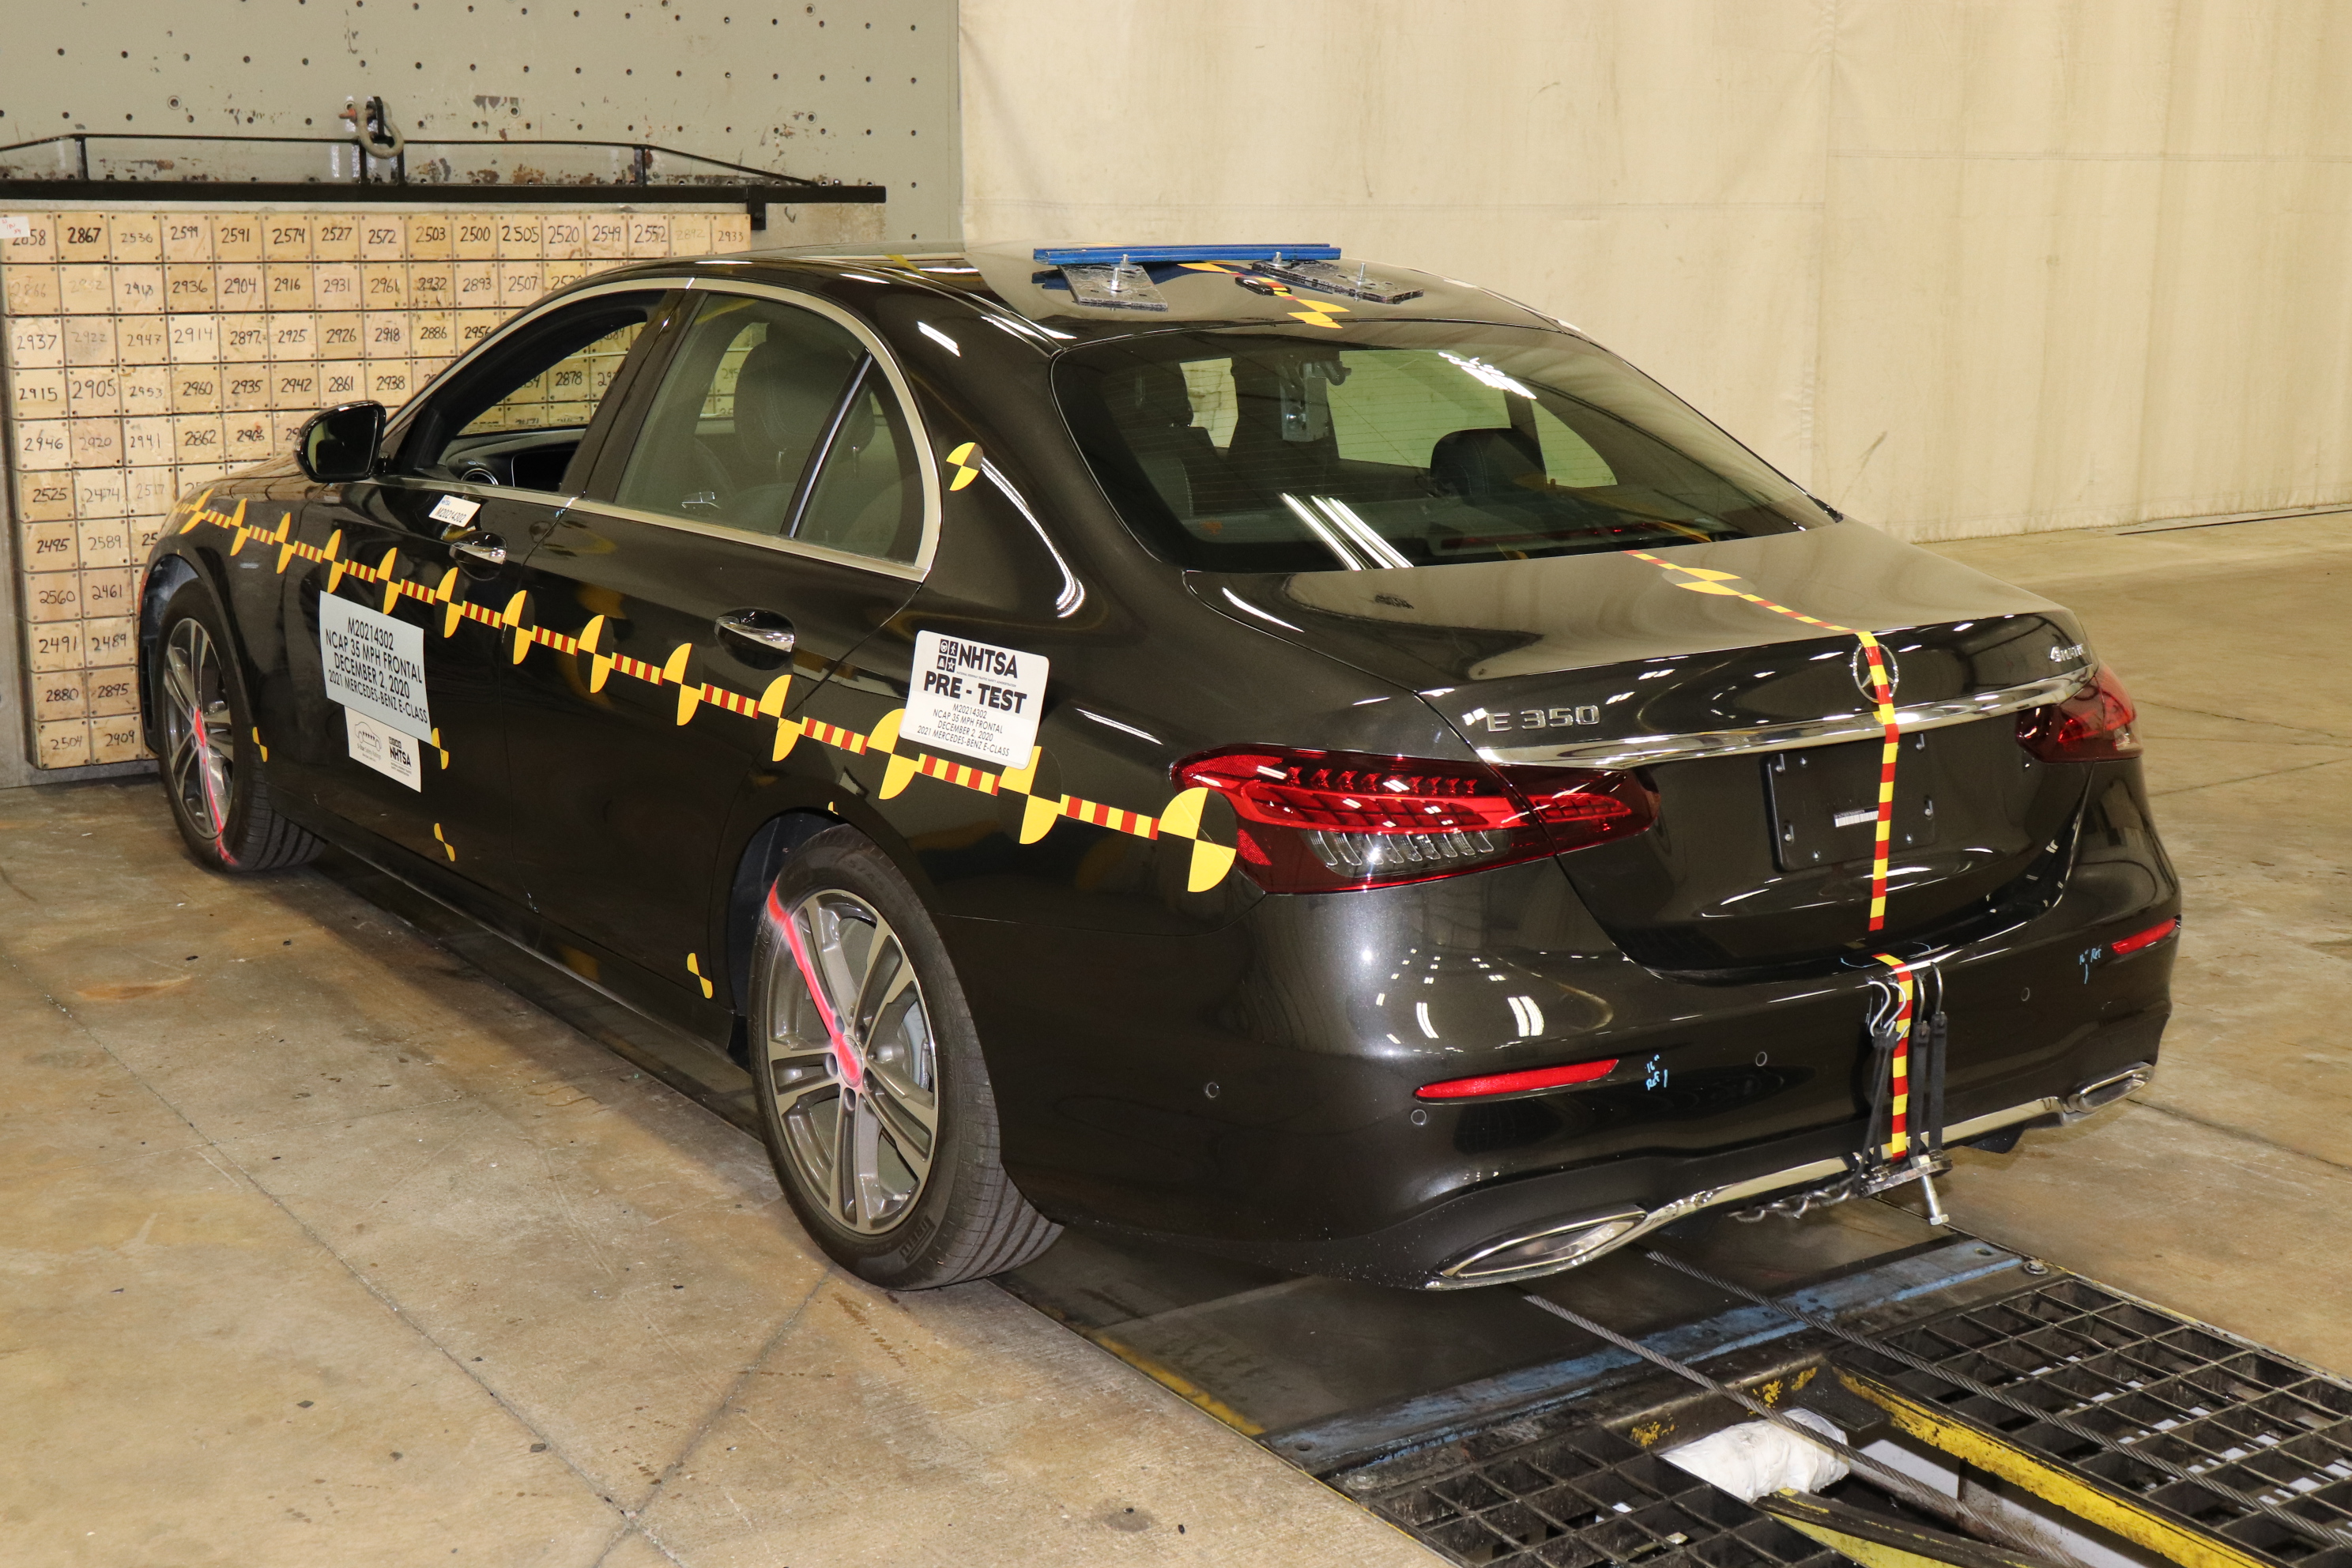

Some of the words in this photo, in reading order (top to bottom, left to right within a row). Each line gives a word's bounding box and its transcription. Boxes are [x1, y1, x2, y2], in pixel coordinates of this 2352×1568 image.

[67, 228, 101, 243] 2867
[122, 232, 153, 243] 2536
[170, 226, 198, 240] 2599
[220, 228, 250, 243] 2591
[272, 228, 305, 244] 2574
[322, 227, 352, 241] 2527
[368, 229, 397, 244] 2572
[416, 227, 446, 243] 2503
[460, 226, 491, 242] 2500
[502, 225, 539, 242] 2505
[548, 225, 579, 243] 2520
[593, 225, 621, 242] 2549
[635, 224, 667, 243] 2552
[718, 230, 744, 242] 2933
[172, 280, 207, 293] 2936
[224, 277, 256, 294] 2904
[274, 277, 300, 292] 2916
[324, 278, 350, 293] 2931
[371, 277, 398, 293] 2961
[418, 277, 447, 291] 2932
[463, 277, 492, 292] 2893
[508, 276, 537, 292] 2507
[175, 327, 213, 344] 2914
[278, 329, 307, 343] 2925
[326, 328, 356, 344] 2926
[420, 326, 447, 340] 2886
[17, 334, 57, 350] 2937
[281, 378, 312, 393] 2942
[329, 376, 354, 392] 2861
[376, 376, 405, 390] 2938
[556, 371, 582, 386] 2878
[18, 387, 58, 401] 2915
[72, 379, 116, 399] 2905
[183, 381, 213, 396] 2960
[232, 380, 263, 394] 2935
[24, 436, 63, 451] 2946
[81, 436, 112, 451] 2920
[130, 433, 160, 449] 2941
[185, 429, 216, 446] 2862
[32, 488, 67, 503] 2525
[85, 488, 119, 503] 2474
[136, 484, 164, 499] 2517
[37, 538, 70, 553] 2495
[88, 535, 122, 551] 2589
[40, 590, 75, 605] 2560
[92, 585, 122, 599] 2461
[347, 616, 394, 651] M20214302
[40, 636, 77, 654] 2491
[92, 634, 126, 651] 2489
[326, 628, 349, 650] NCAP
[351, 642, 360, 658] 35
[362, 646, 382, 667] MPH
[383, 652, 422, 684] FRONTAL
[958, 643, 1018, 679] NHTSA
[334, 652, 377, 682] DECEMBER
[379, 673, 387, 692] 2,
[389, 674, 410, 699] 2020
[46, 688, 79, 703] 2880
[97, 683, 130, 699] 2895
[329, 669, 344, 688] 2021
[345, 674, 398, 711] MERCEDES-BENZ
[399, 701, 428, 724] E-CLASS
[923, 670, 963, 699] PRE
[978, 683, 1027, 714] TEST
[952, 703, 987, 719] M20214302
[1487, 712, 1513, 733] E
[1521, 705, 1600, 729] 350
[933, 709, 951, 720] NCAP
[952, 714, 959, 723] 35
[960, 715, 974, 726] MPH
[975, 719, 1003, 734] FRONTAL
[105, 730, 134, 748] 2909
[937, 720, 970, 735] DECEMBER
[978, 730, 993, 742] 2020
[51, 735, 82, 750] 2504
[917, 725, 931, 736] 2021
[932, 729, 982, 750] MERCEDES-BENZ
[983, 743, 1010, 757] E-CLASS
[389, 745, 412, 767] NHTSA
